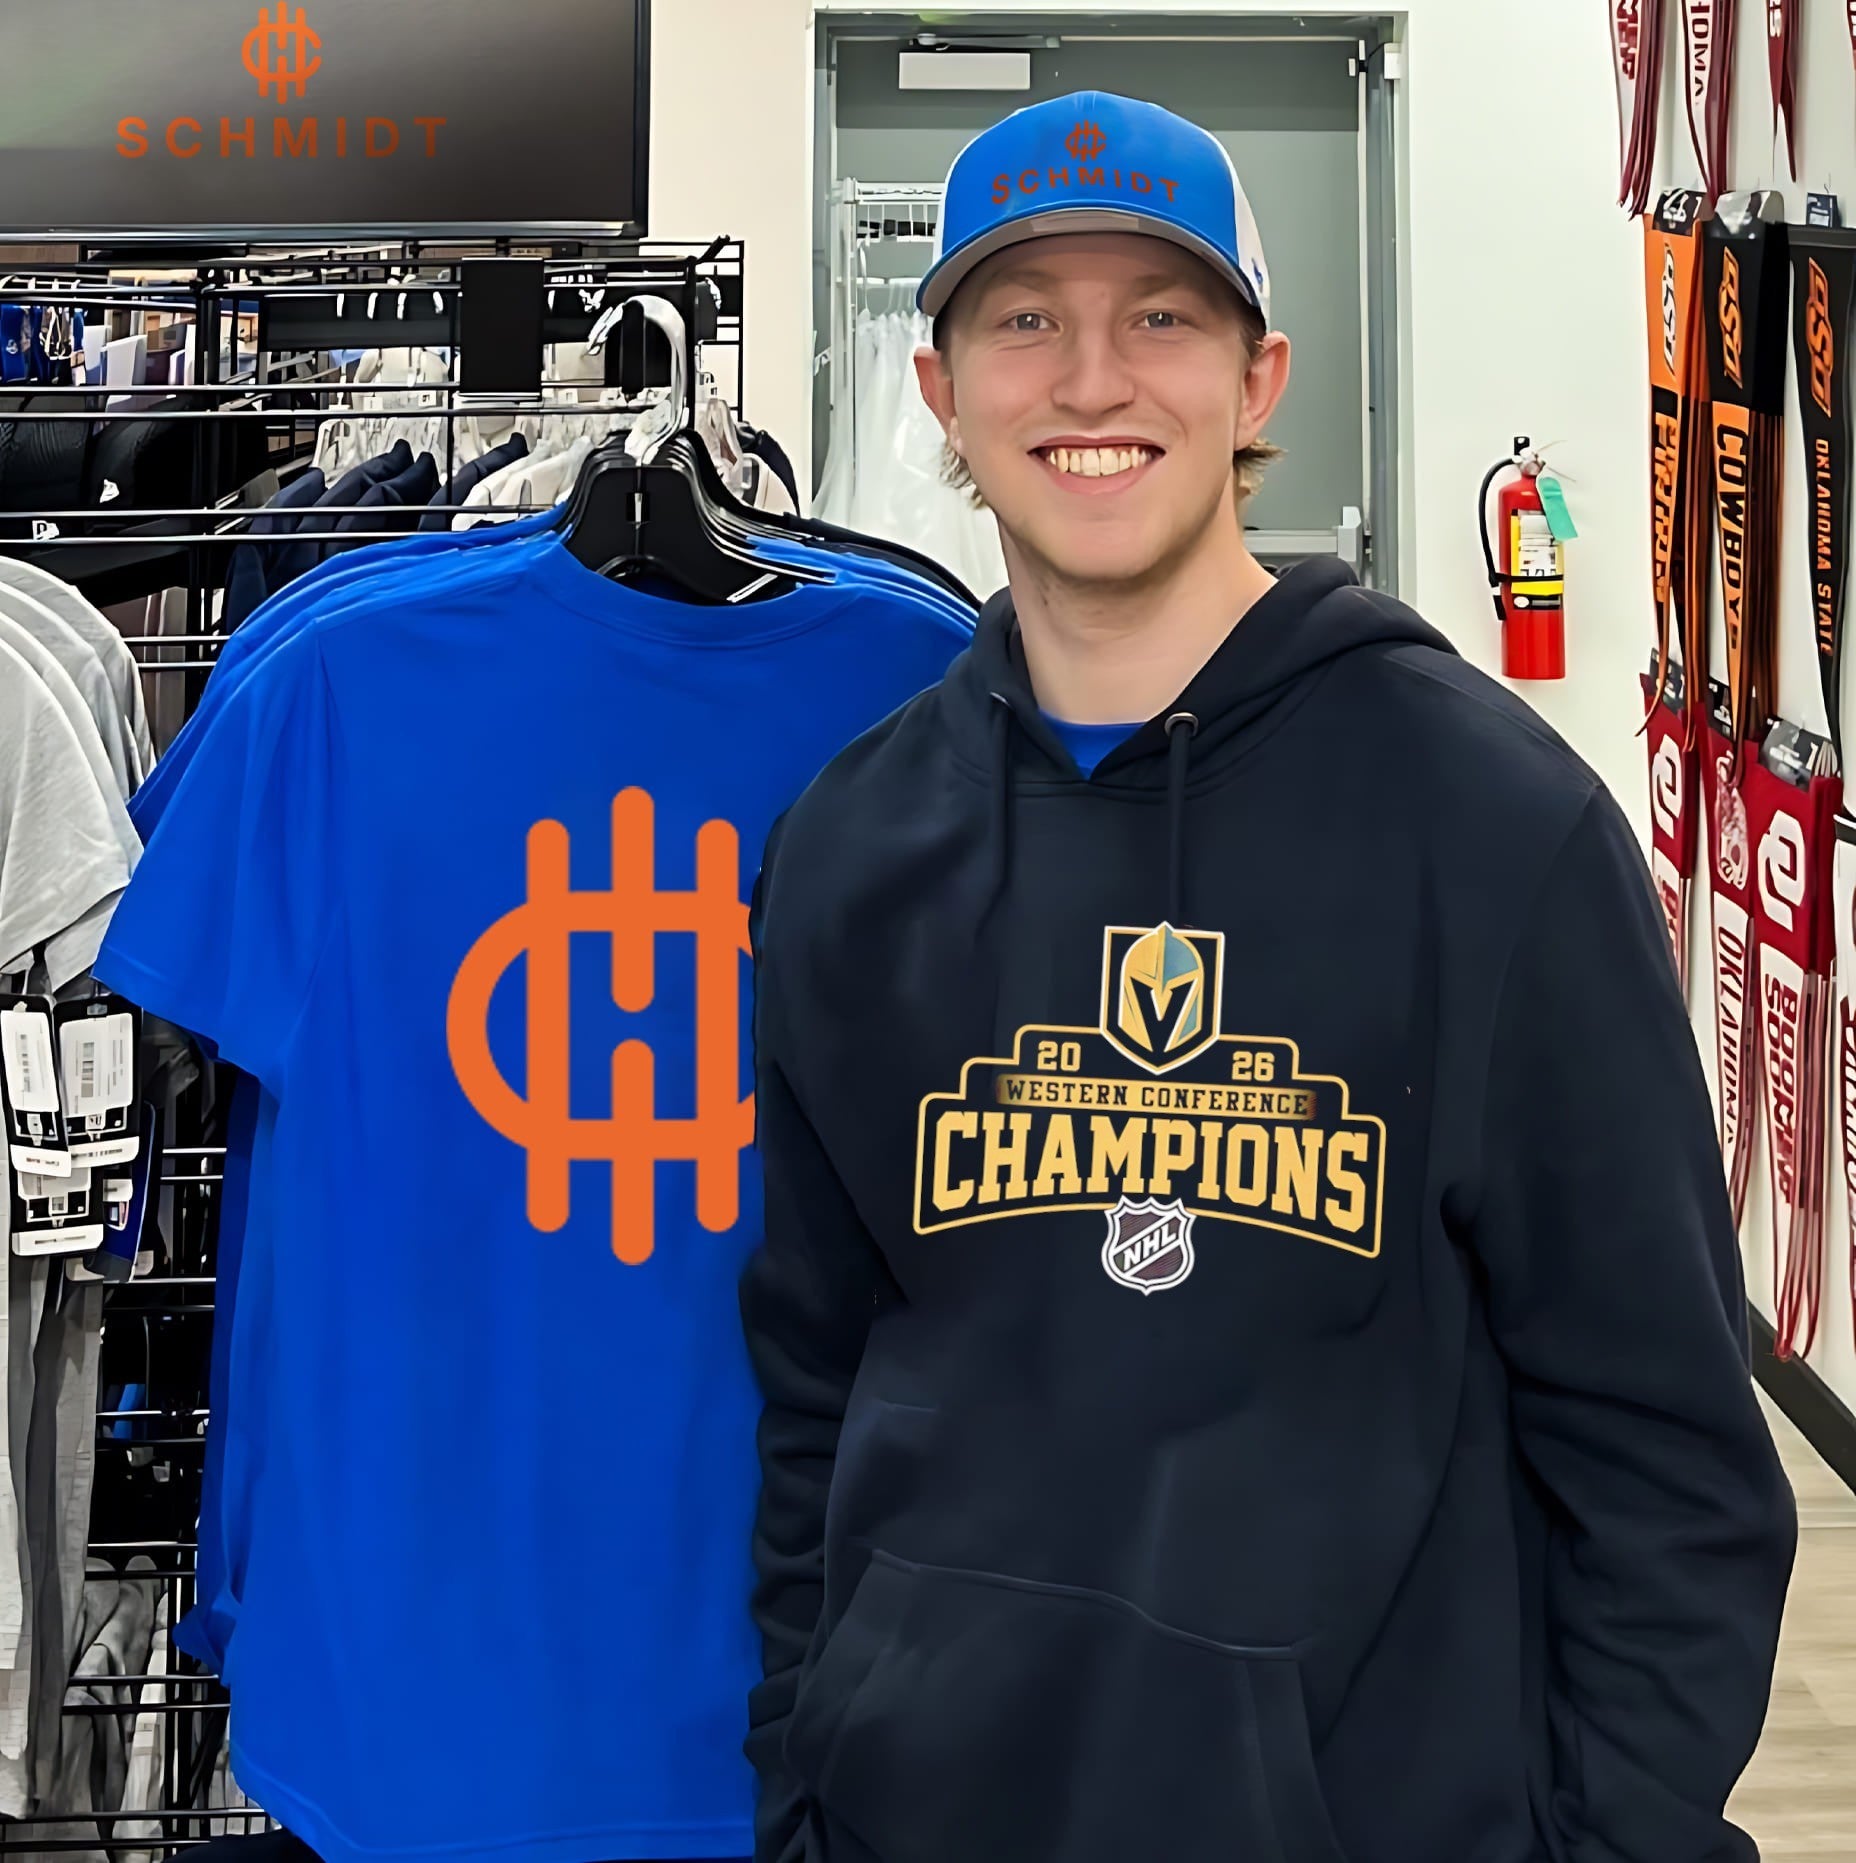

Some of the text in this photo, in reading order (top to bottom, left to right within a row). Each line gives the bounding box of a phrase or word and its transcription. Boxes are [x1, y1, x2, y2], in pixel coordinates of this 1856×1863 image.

[116, 117, 448, 158] SCHMIDT
[991, 166, 1179, 205] SCHMIDT
[1815, 438, 1832, 570] OKLAHOMA
[1717, 925, 1745, 1144] OKLAHOMA
[1037, 1040, 1275, 1082] 20 26
[1006, 1079, 1308, 1116] WESTERN CONFERENCE
[932, 1110, 1369, 1233] CHAMPIONS
[1122, 1223, 1178, 1271] NHL
